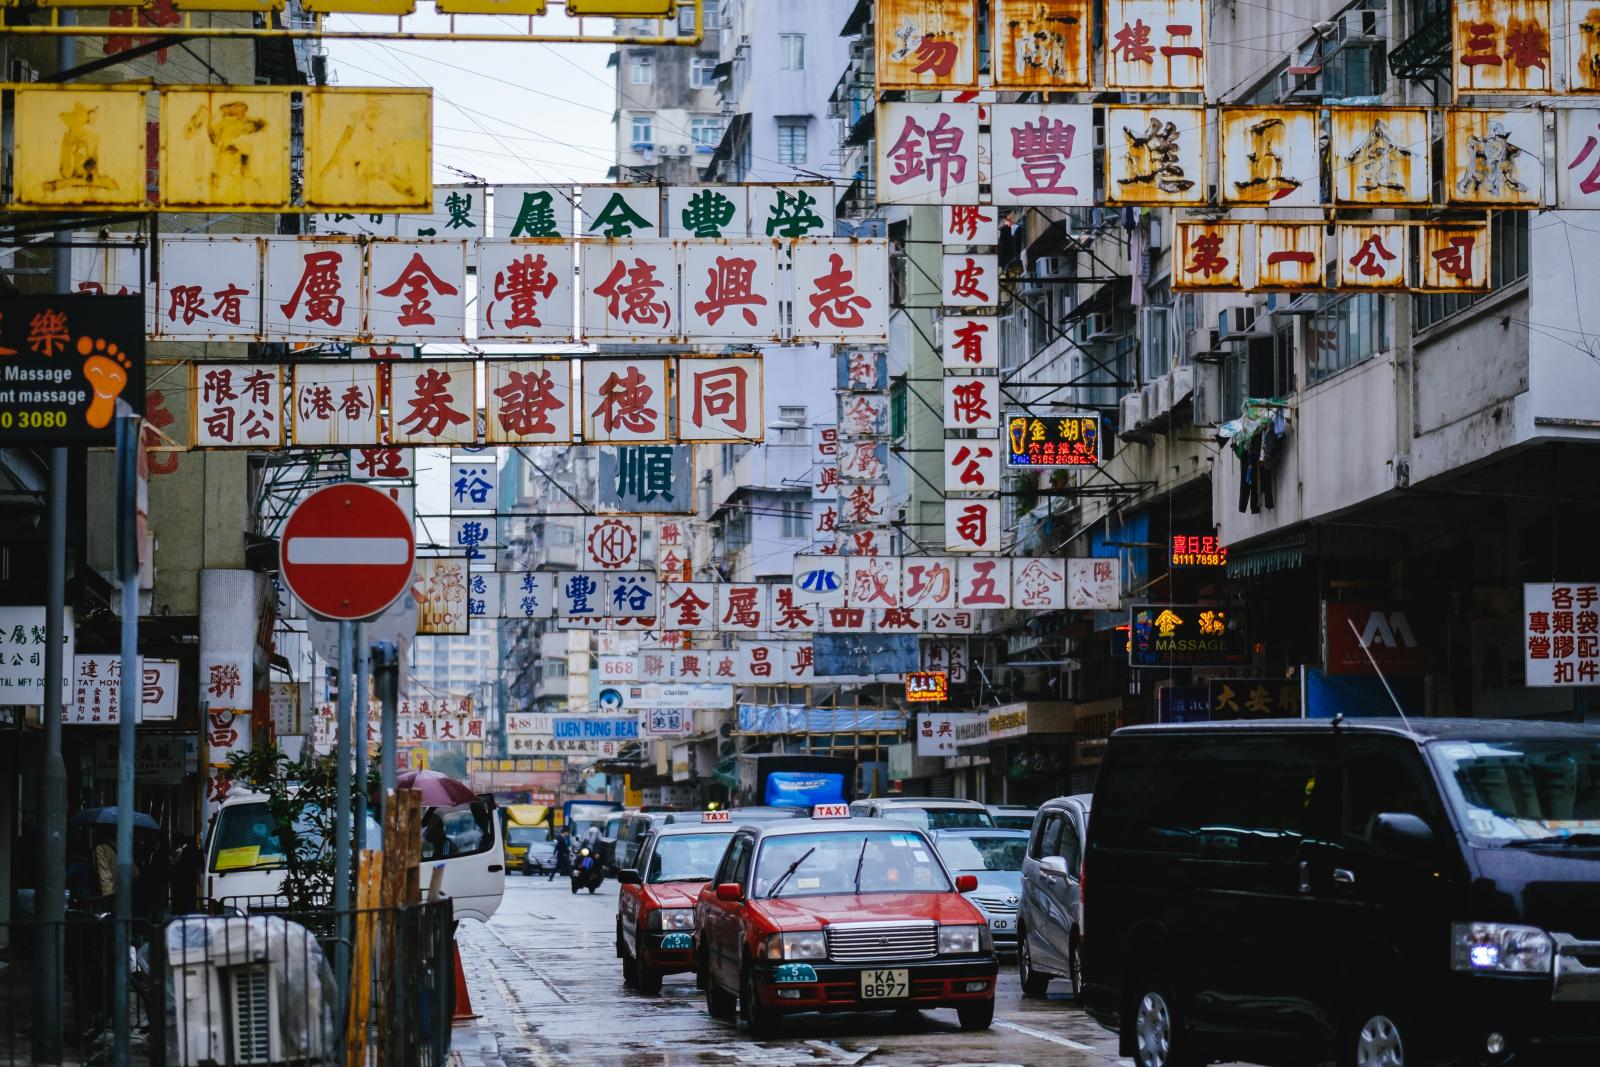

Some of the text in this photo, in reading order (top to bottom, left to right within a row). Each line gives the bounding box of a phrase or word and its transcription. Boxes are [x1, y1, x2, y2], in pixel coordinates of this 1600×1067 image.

[1185, 232, 1476, 280] 第一公司
[5, 366, 72, 383] Massage
[20, 390, 86, 405] massage
[18, 412, 67, 427] 3080
[1029, 418, 1079, 441] 金湖
[617, 446, 675, 502] 順
[1173, 554, 1195, 565] 5111
[1156, 640, 1227, 650] MASSAGE
[605, 662, 633, 674] 668
[18, 678, 32, 686] MFY
[556, 721, 580, 737] LUEN
[585, 721, 611, 736] FUNG
[706, 812, 729, 820] TAXI
[818, 806, 846, 816] TAXI
[994, 920, 1007, 928] GD
[791, 968, 799, 976] 5
[875, 971, 896, 983] KA
[864, 984, 906, 998] 8677
